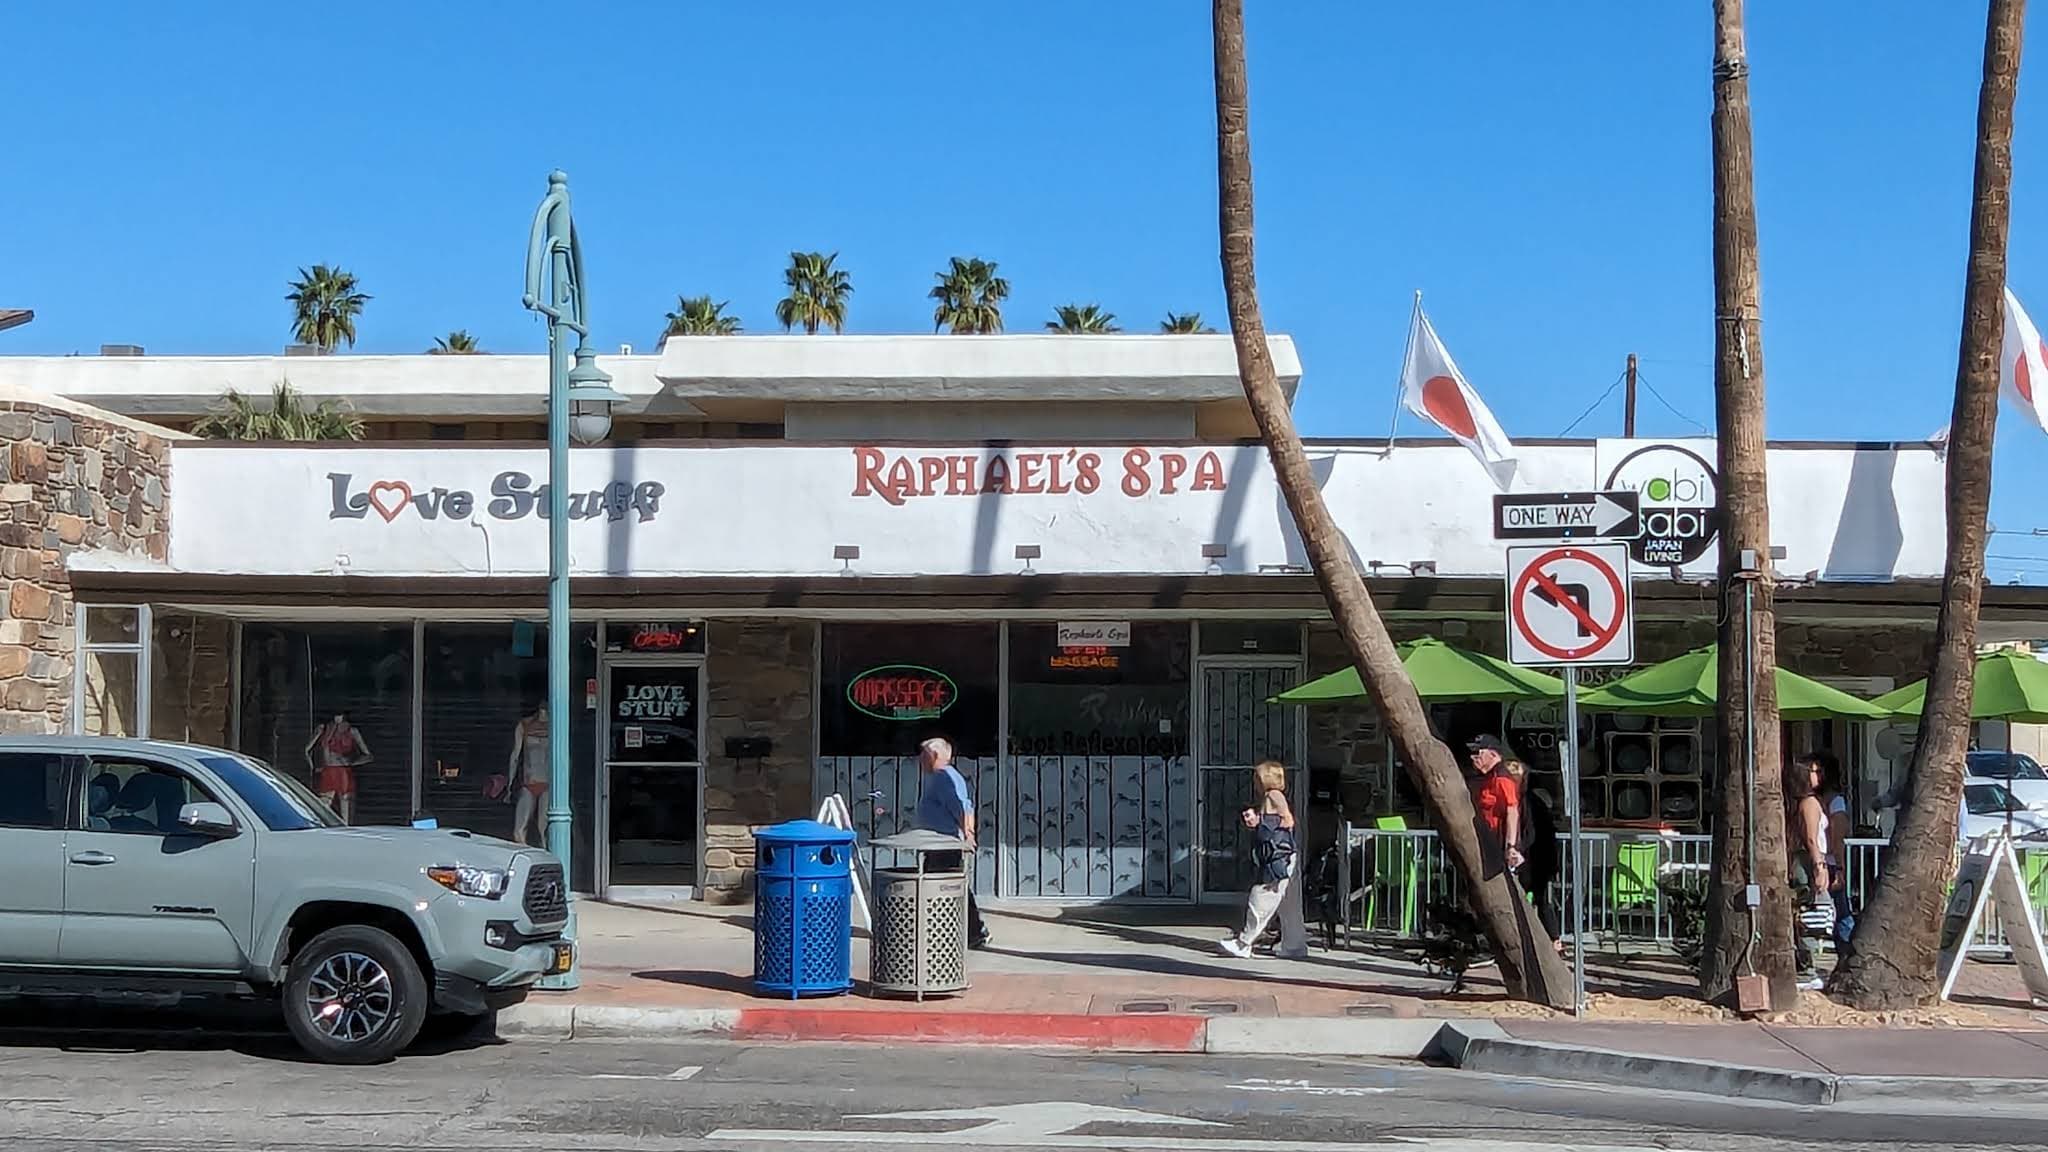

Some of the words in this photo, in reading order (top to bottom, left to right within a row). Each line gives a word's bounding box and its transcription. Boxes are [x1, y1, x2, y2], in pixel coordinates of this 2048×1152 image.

[487, 471, 665, 523] Stuff
[1508, 508, 1547, 525] ONE
[1554, 506, 1595, 525] WAY
[1644, 540, 1682, 551] JAPAN
[1644, 551, 1682, 563] LIVING
[633, 631, 683, 647] OPEN
[625, 685, 685, 700] LOVE
[618, 701, 691, 717] STUFF
